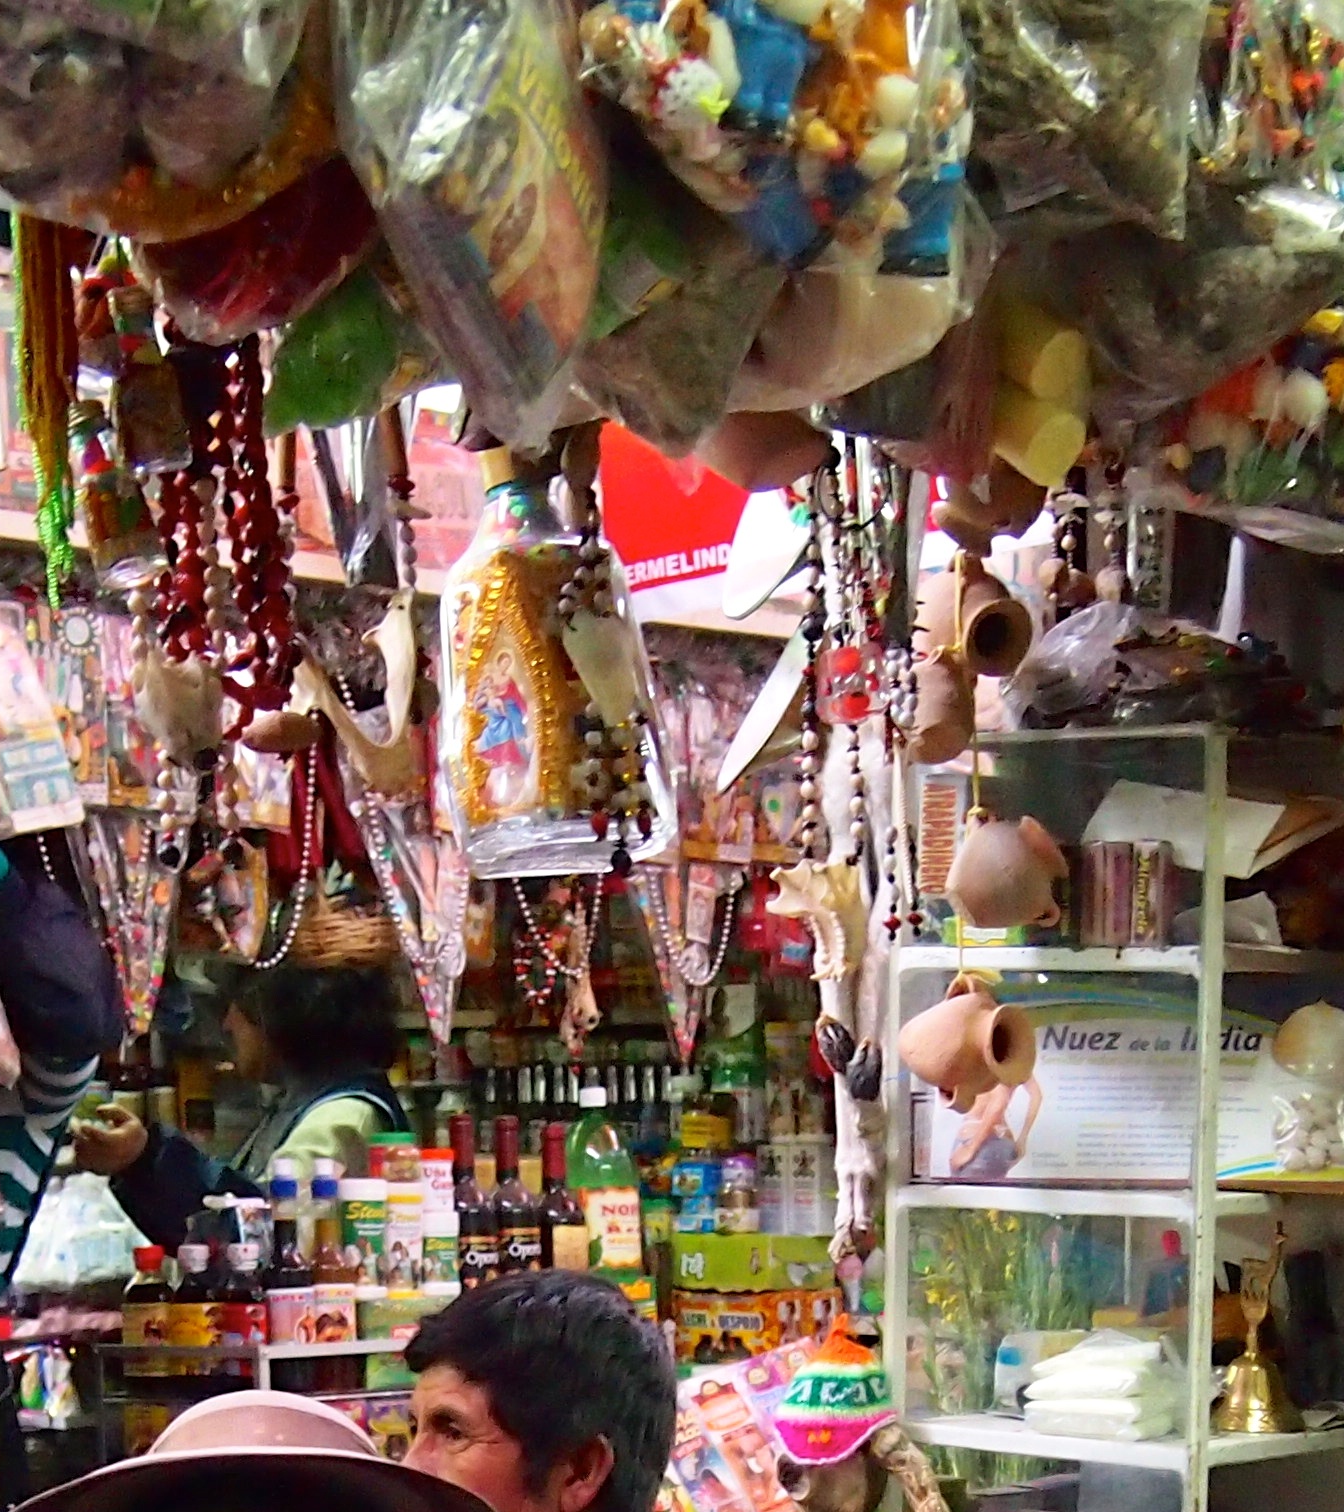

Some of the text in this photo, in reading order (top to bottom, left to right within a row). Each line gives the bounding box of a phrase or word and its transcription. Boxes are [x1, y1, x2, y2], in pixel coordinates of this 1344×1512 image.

[918, 783, 957, 894] ATRAPADINERO
[1042, 1025, 1122, 1051] Nuez
[1129, 1037, 1150, 1051] de
